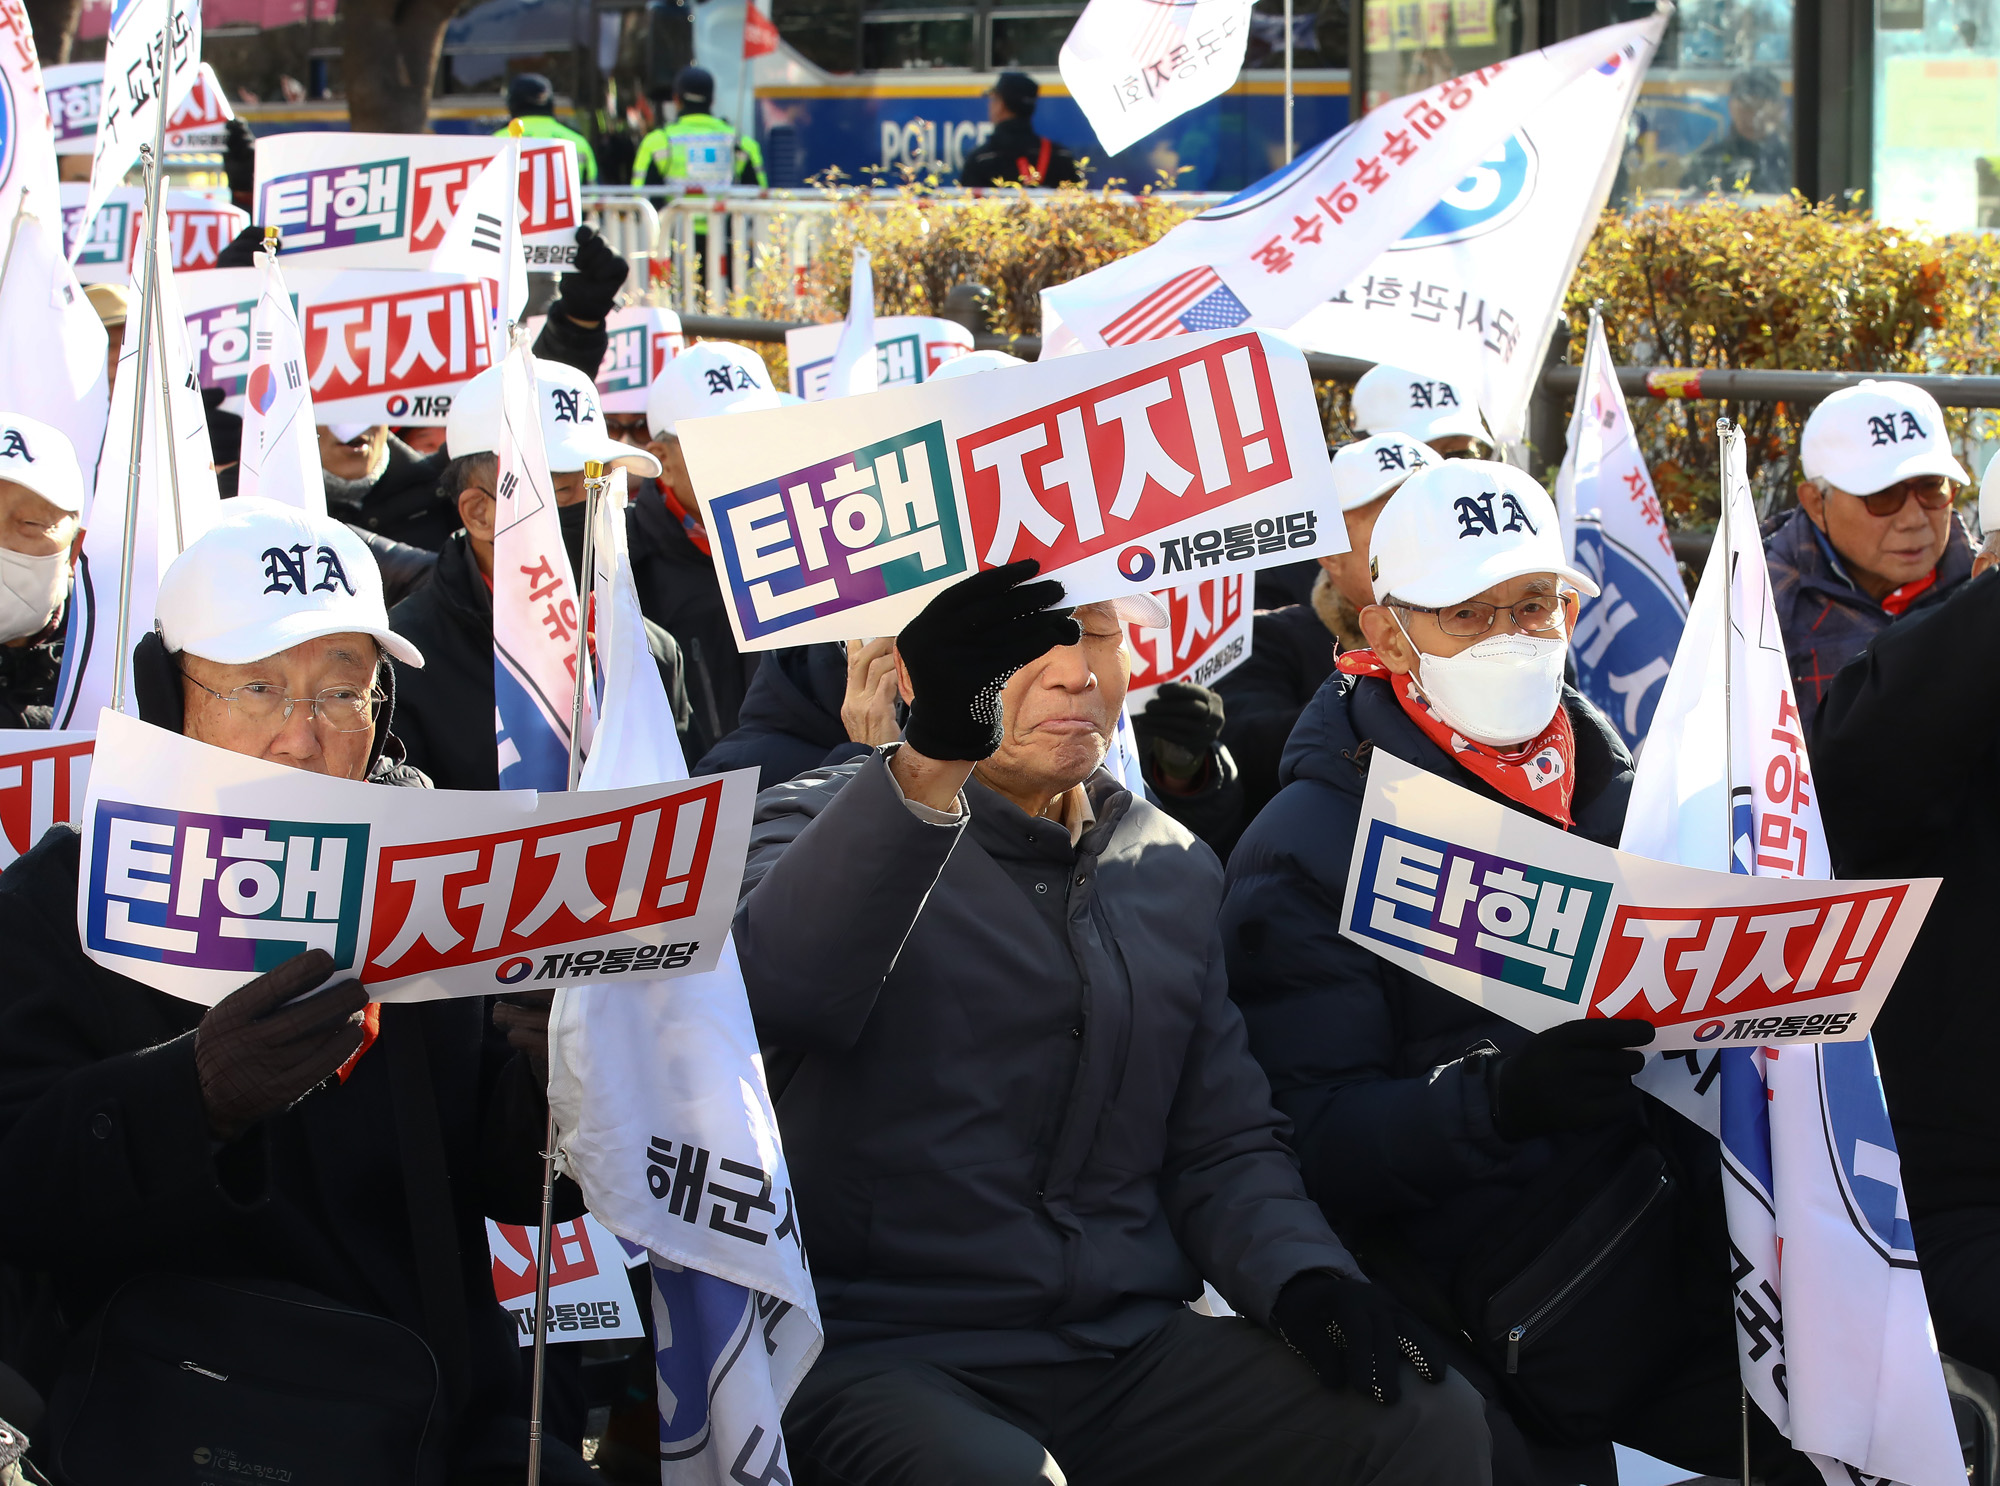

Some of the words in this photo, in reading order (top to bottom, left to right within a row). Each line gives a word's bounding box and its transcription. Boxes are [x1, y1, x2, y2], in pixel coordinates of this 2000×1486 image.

[265, 164, 400, 248] 탄핵
[310, 288, 490, 392] 저지!
[704, 364, 761, 395] NA
[1410, 382, 1459, 409] NA
[1867, 410, 1927, 447] NA
[726, 441, 948, 623] 탄핵
[971, 346, 1274, 566] 저지!
[1160, 510, 1317, 574] 자유통일당
[1453, 491, 1539, 539] NA
[261, 543, 357, 597] NA
[104, 817, 349, 958] 탄핵
[371, 798, 708, 968] 저지!
[1368, 834, 1594, 991] 탄핵
[1595, 894, 1895, 1018] 저지!
[534, 941, 701, 980] 자유통일당
[1724, 1012, 1858, 1042] 자유통일당
